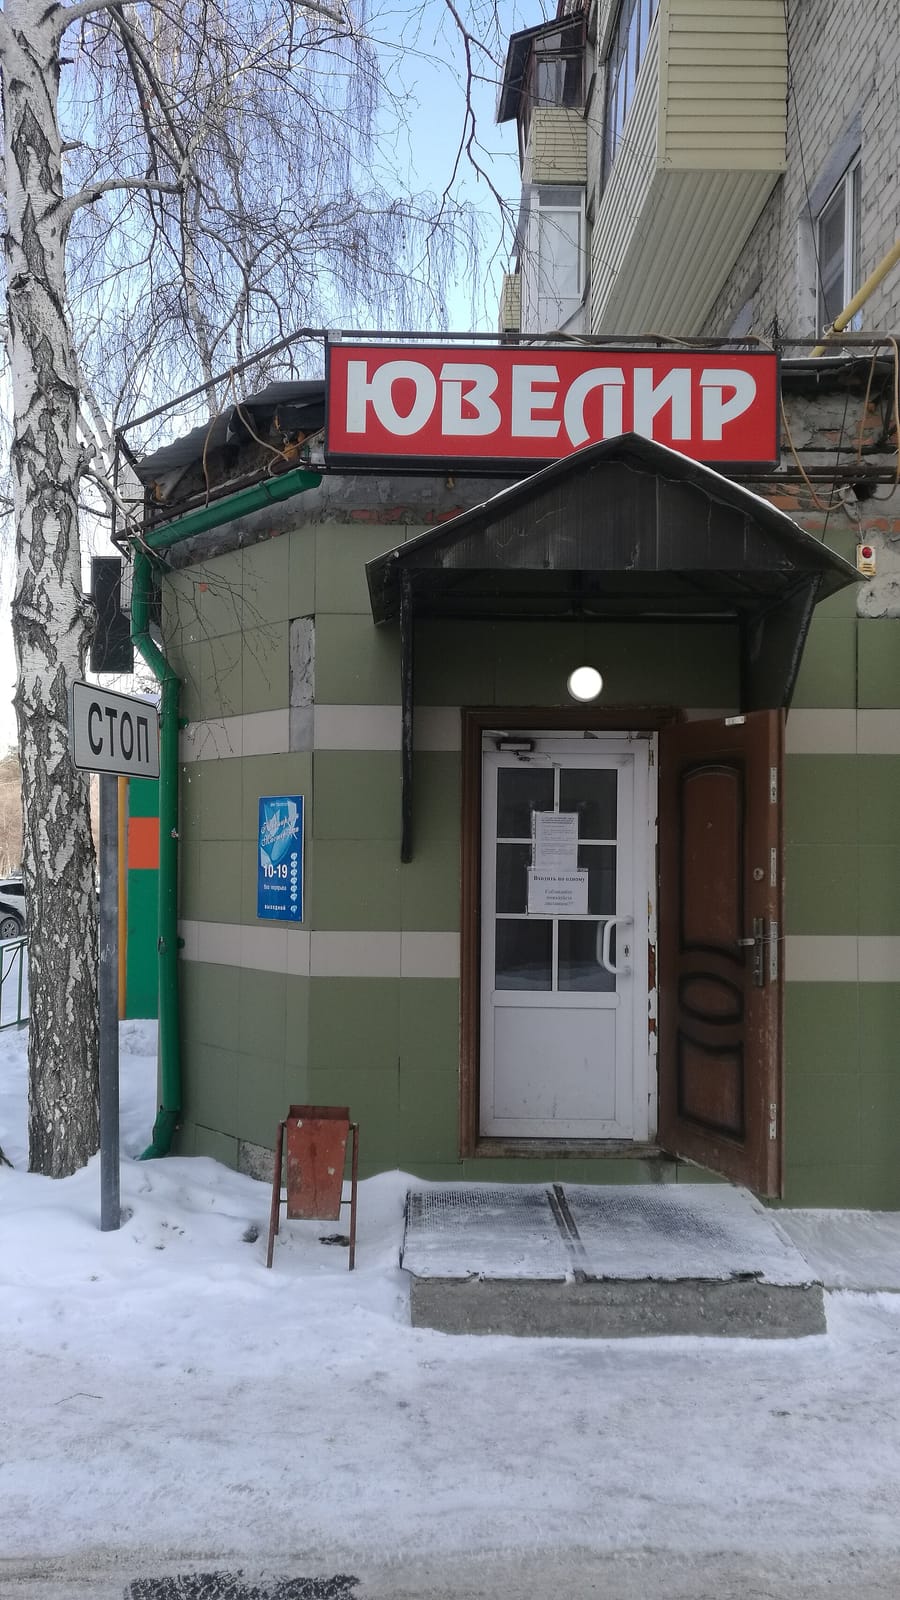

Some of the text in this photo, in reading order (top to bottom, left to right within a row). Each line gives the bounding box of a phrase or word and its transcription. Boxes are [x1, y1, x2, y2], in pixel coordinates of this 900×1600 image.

[346, 360, 757, 447] ЮВЕЛИР
[88, 702, 149, 763] СТОП
[264, 864, 288, 878] 10-19
